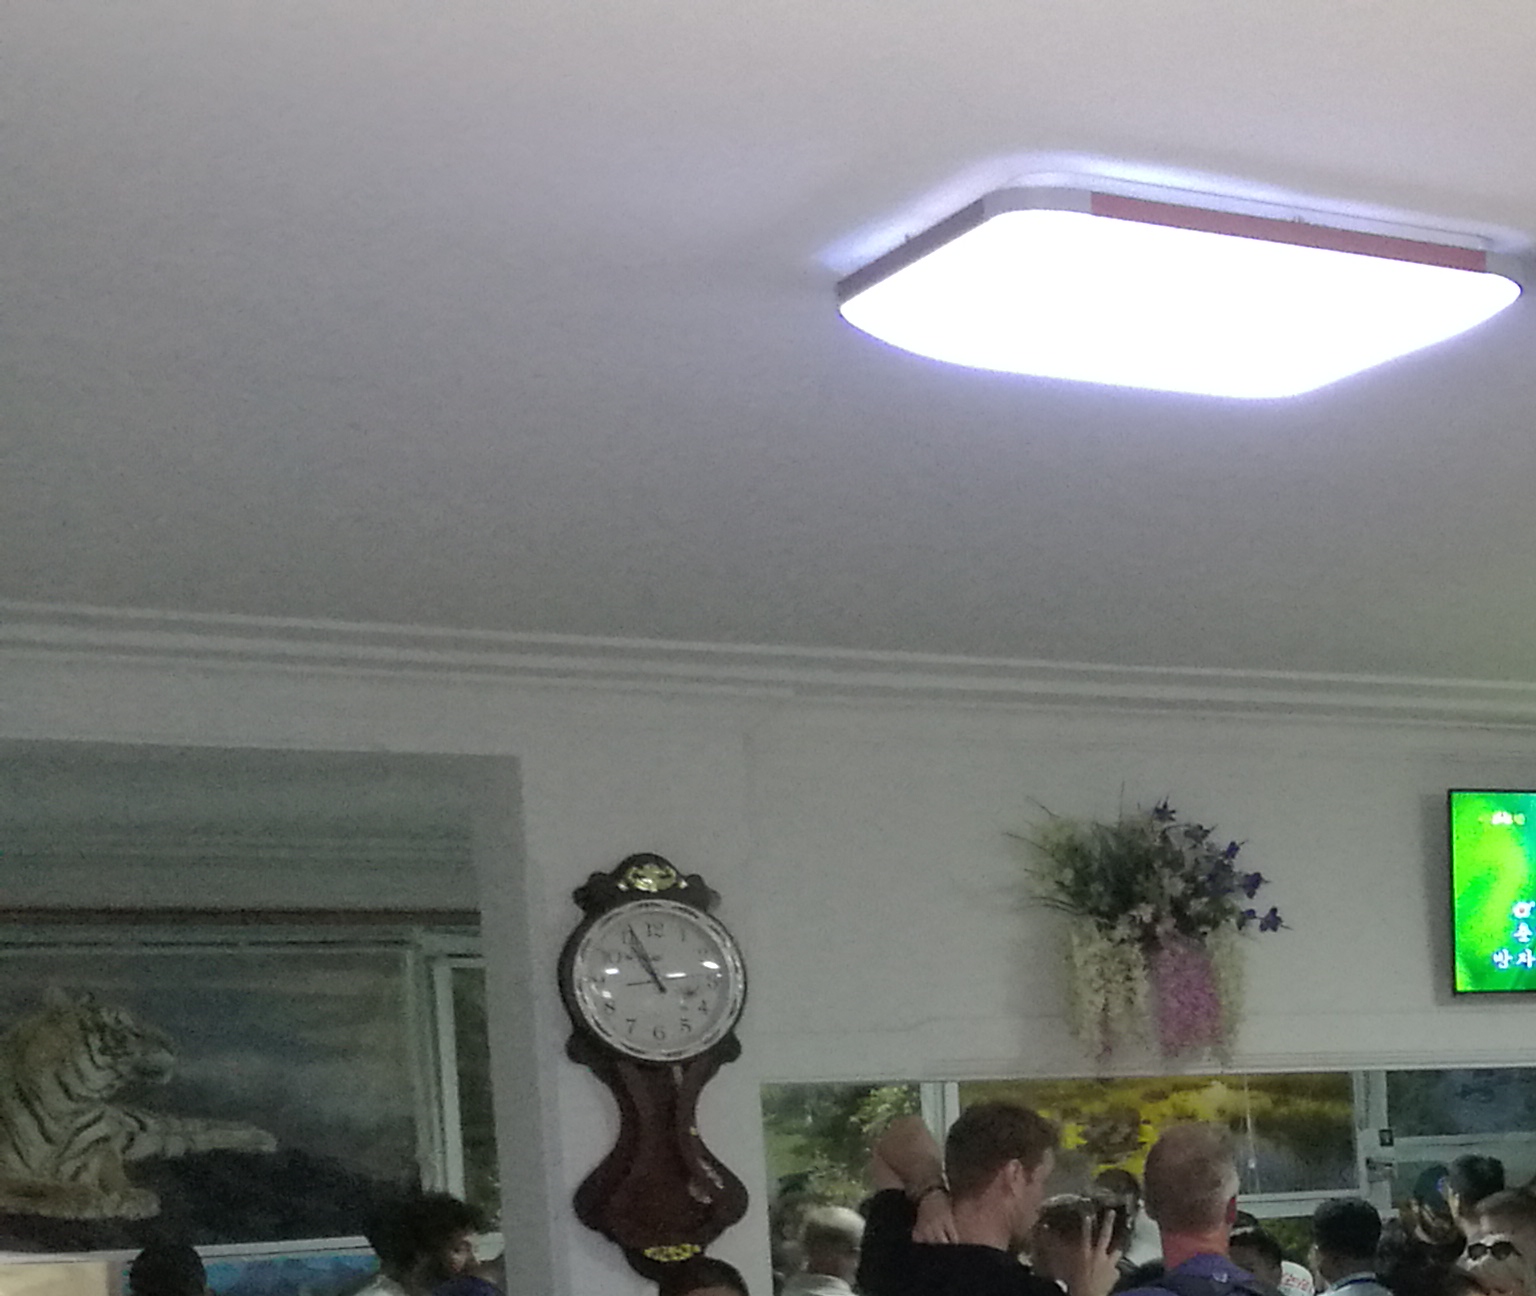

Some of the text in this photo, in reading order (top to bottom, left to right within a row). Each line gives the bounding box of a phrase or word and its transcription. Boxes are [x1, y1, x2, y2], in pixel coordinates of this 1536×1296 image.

[645, 922, 665, 939] 12
[625, 1017, 637, 1034] 7
[652, 1026, 666, 1041] 6
